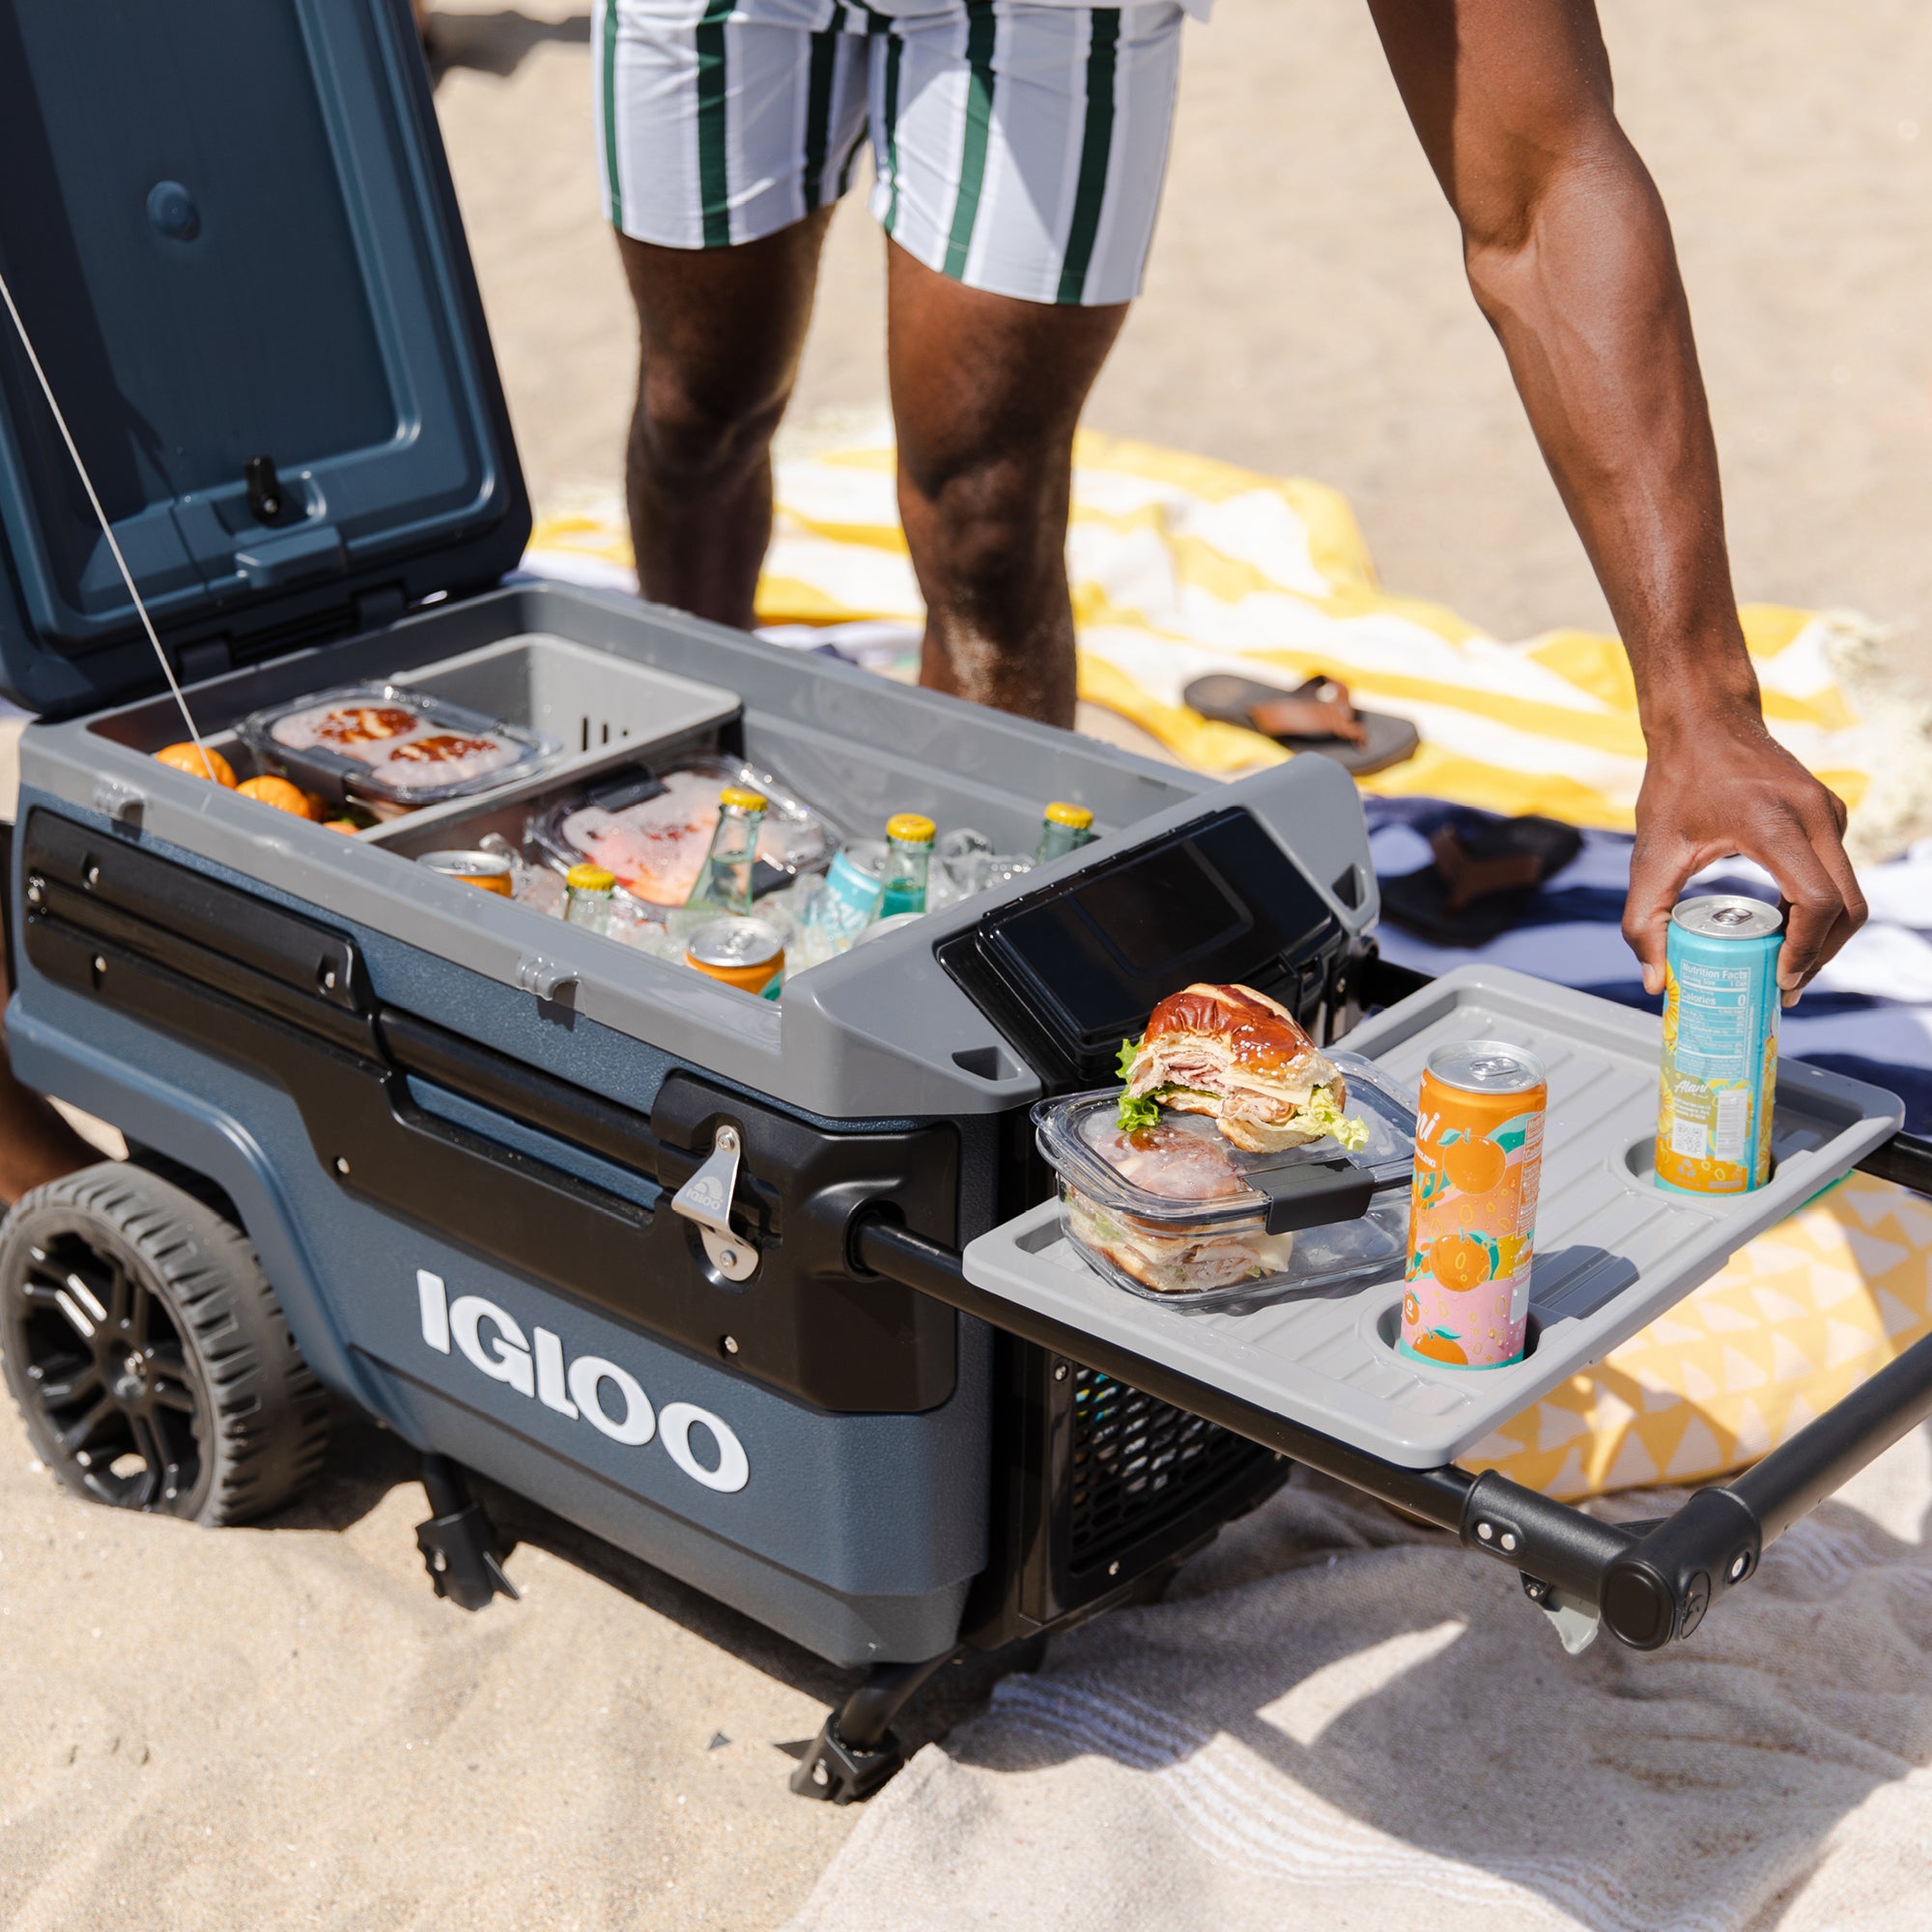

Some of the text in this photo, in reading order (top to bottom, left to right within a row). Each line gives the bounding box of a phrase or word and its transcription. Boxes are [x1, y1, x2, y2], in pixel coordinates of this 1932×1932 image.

[1683, 962, 1747, 981] Nutrition Facts
[1703, 978, 1716, 986] Size
[1682, 989, 1717, 1006] Calories
[1737, 994, 1747, 1007] 0
[686, 1187, 722, 1210] IGLOO
[416, 1268, 750, 1493] IGLOO
